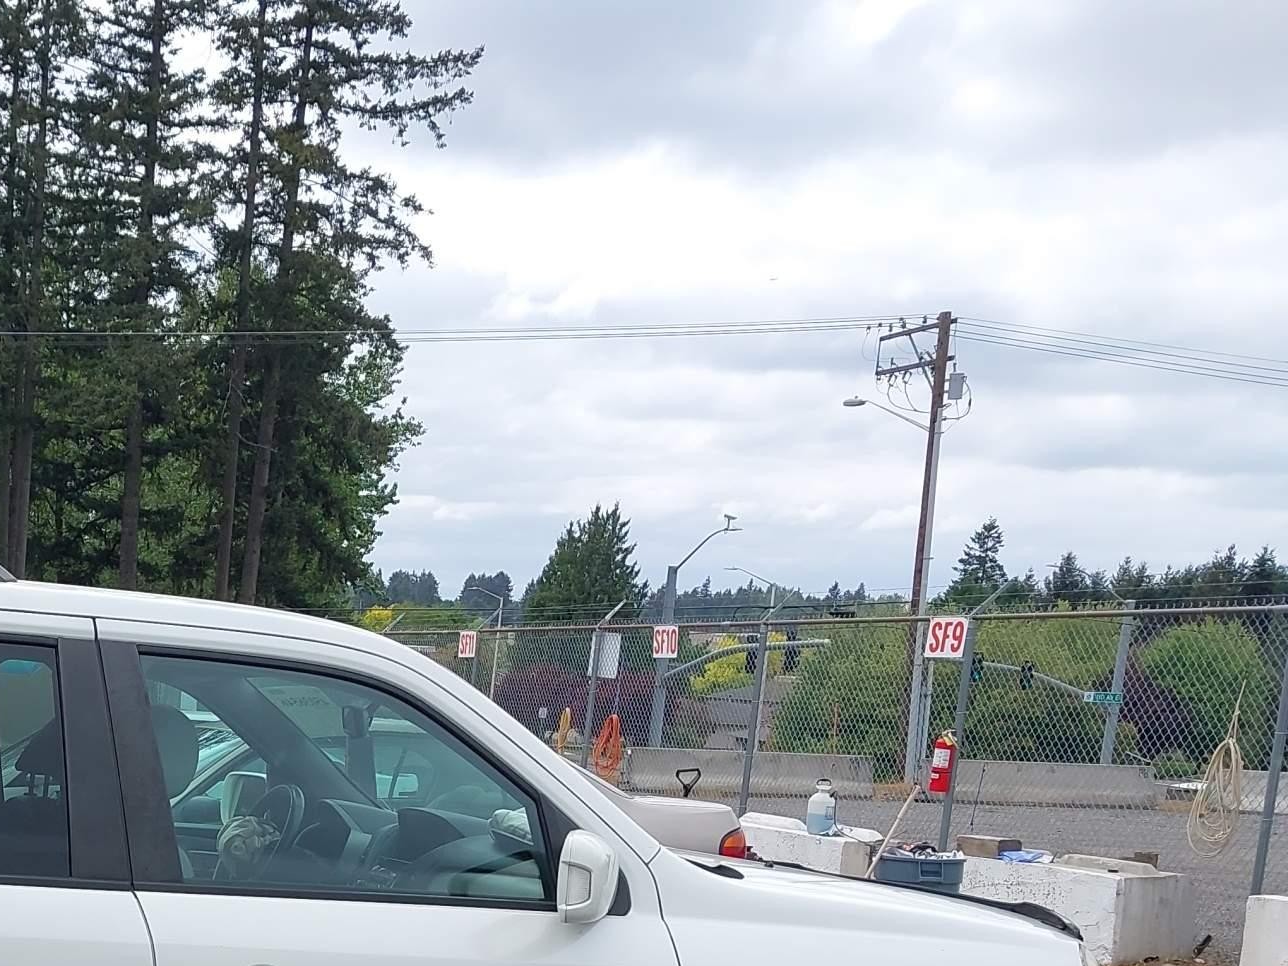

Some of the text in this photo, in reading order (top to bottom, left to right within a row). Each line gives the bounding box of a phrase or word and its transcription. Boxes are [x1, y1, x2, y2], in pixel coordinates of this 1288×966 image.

[460, 633, 475, 655] SF11
[655, 629, 677, 654] SF10
[929, 621, 964, 652] SF9
